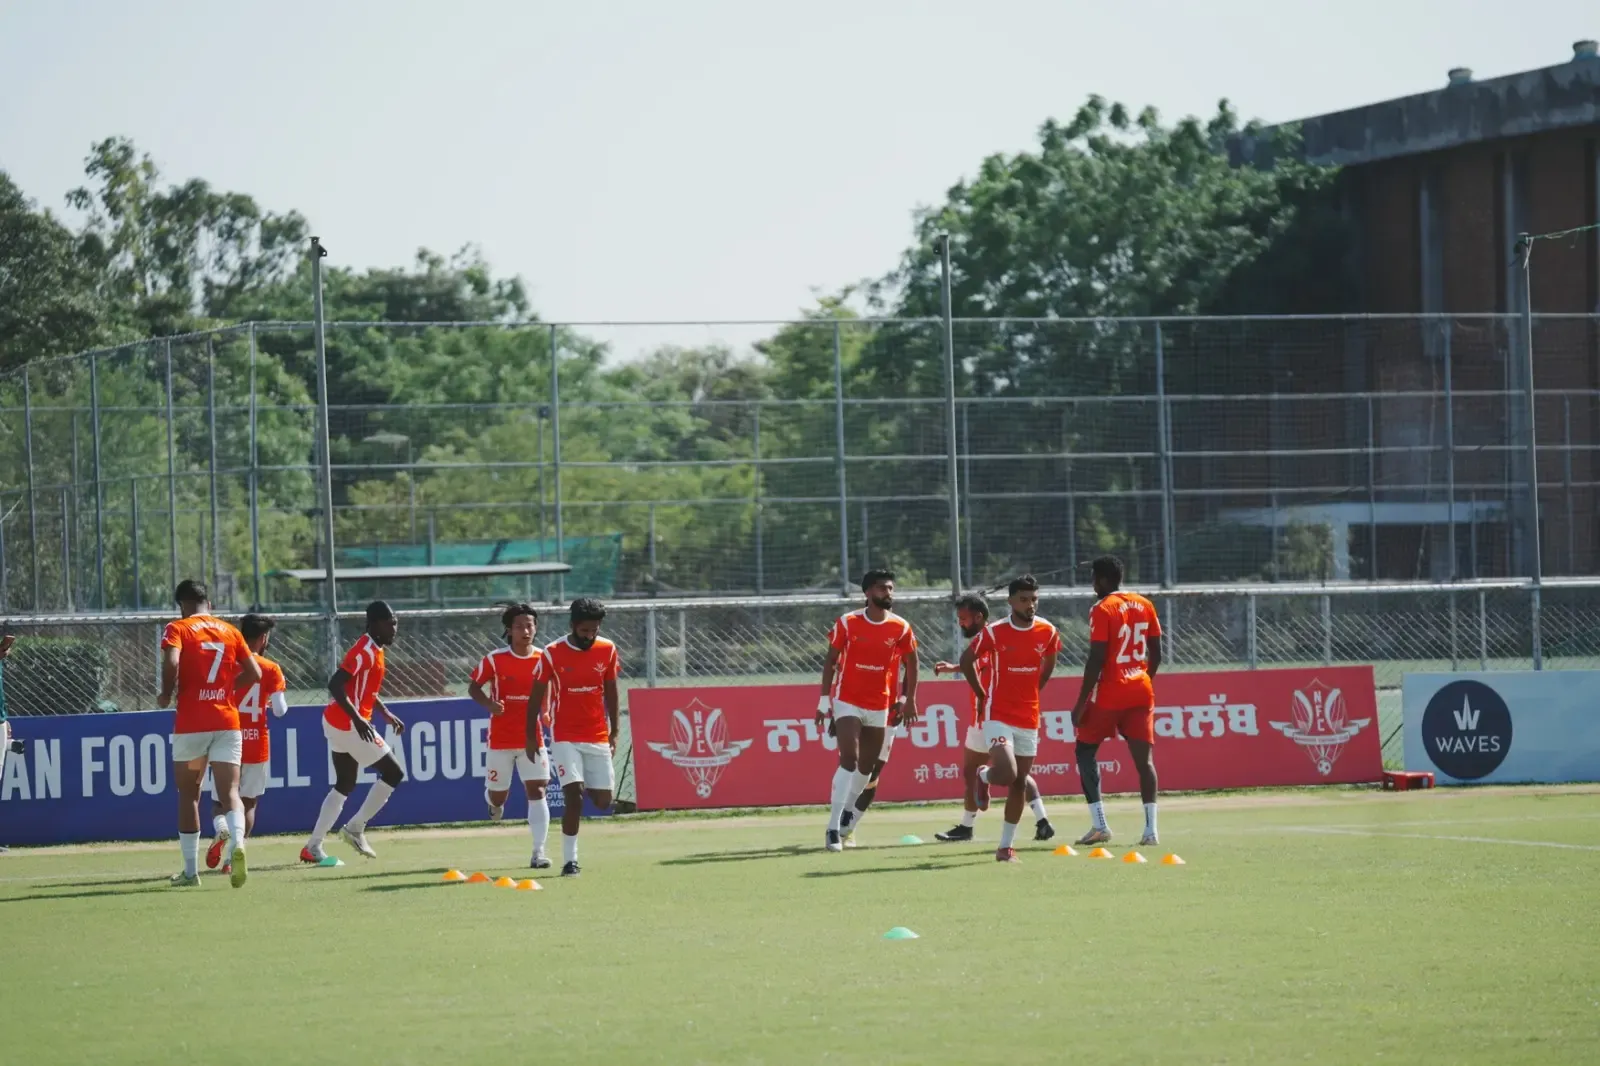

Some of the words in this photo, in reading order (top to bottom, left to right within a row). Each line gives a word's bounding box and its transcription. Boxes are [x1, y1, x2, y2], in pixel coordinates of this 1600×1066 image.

[201, 642, 225, 683] 7
[1116, 622, 1149, 664] 25
[1435, 735, 1501, 754] WAVES
